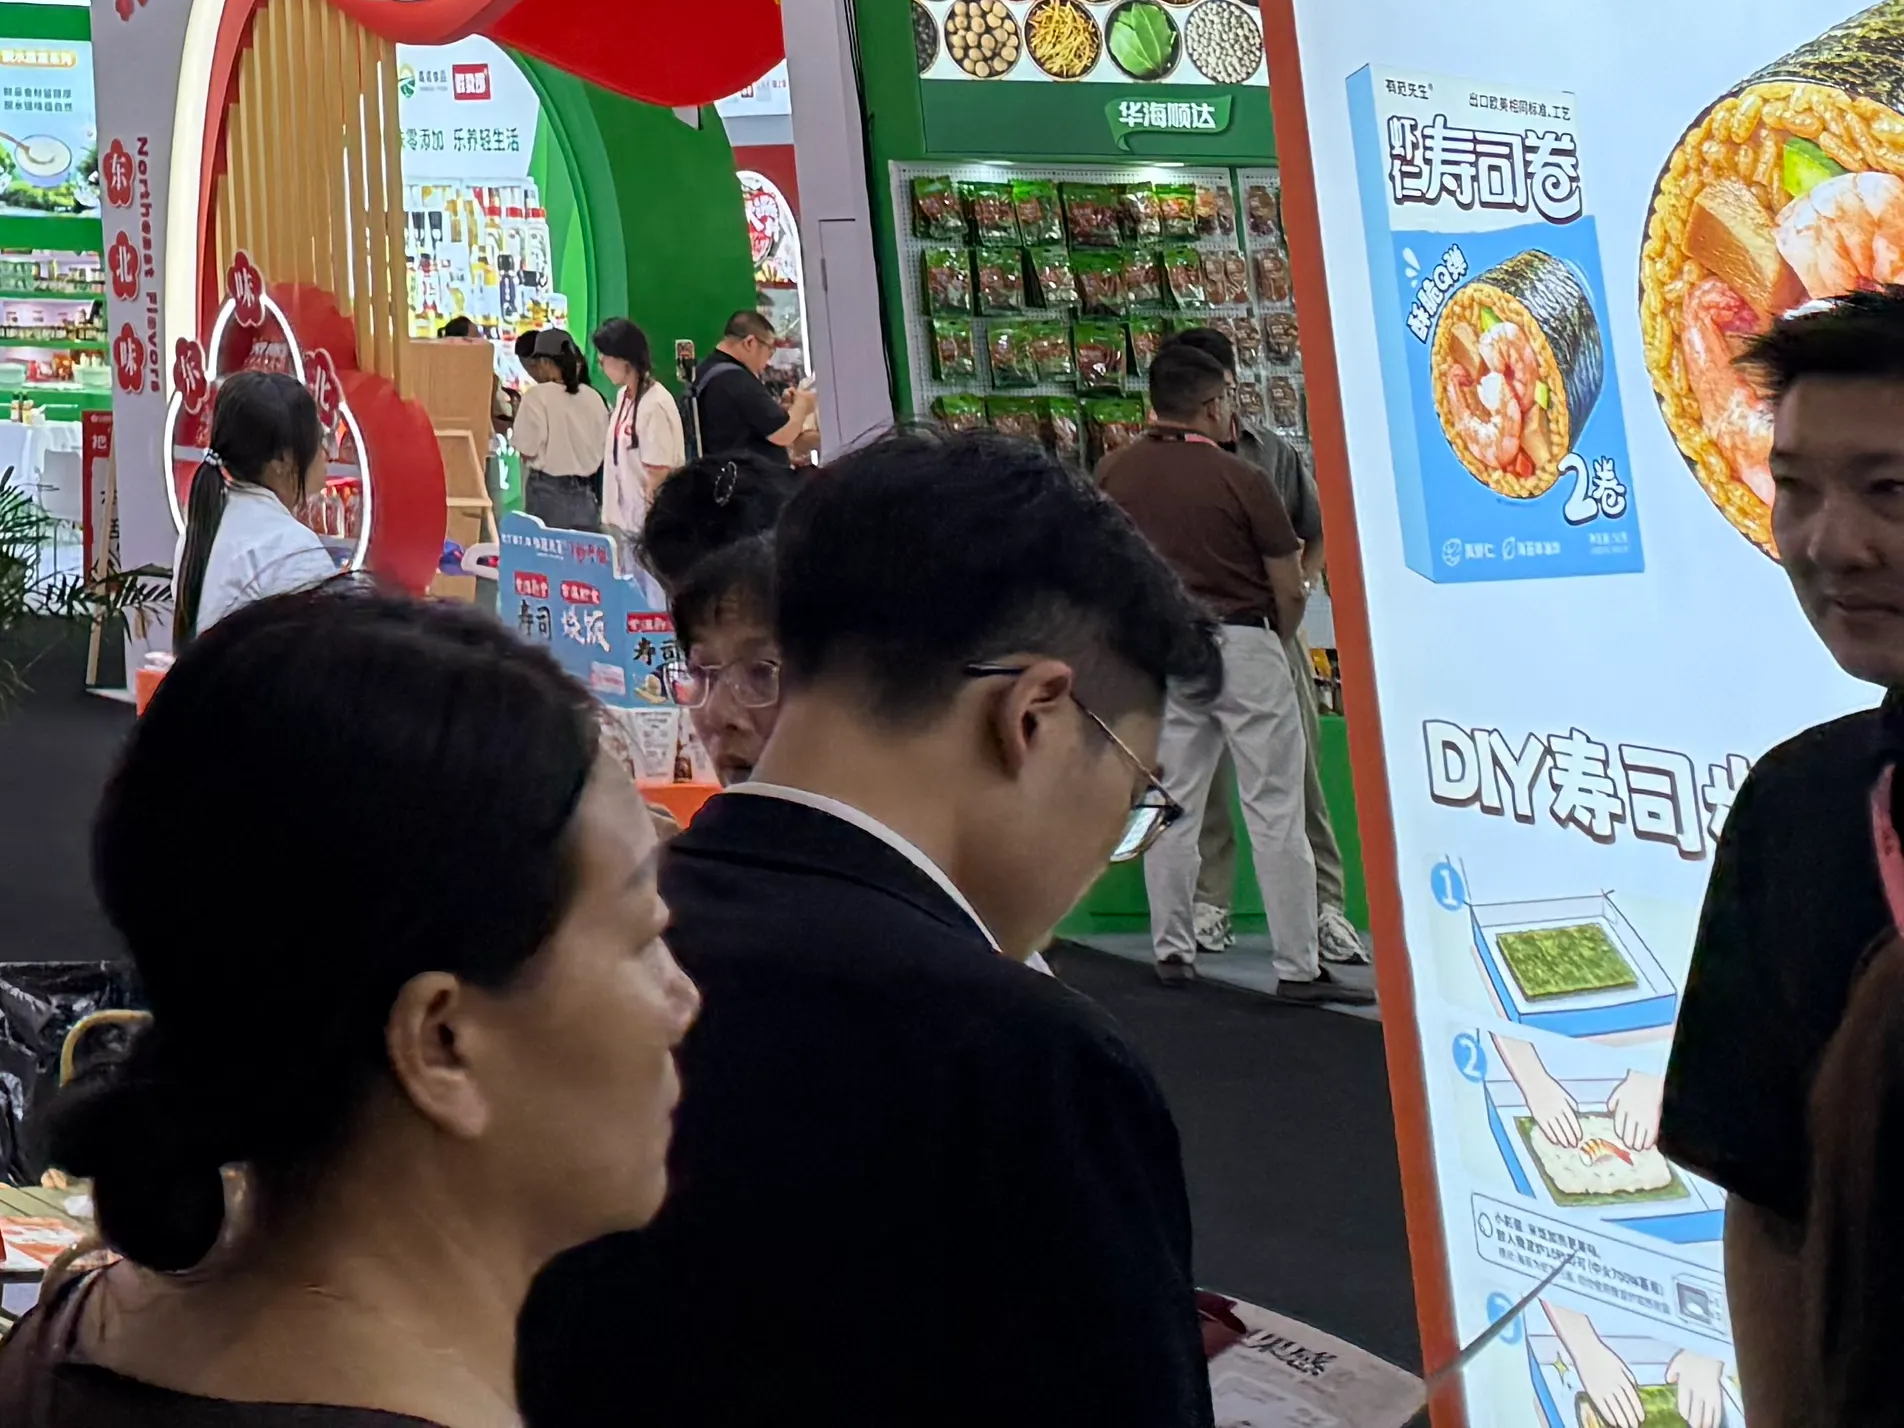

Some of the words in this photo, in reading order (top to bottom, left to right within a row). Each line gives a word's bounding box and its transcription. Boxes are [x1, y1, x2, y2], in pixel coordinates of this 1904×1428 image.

[1118, 101, 1216, 131] 华海顺达
[1421, 113, 1583, 226] 寿司卷
[137, 137, 156, 279] Northeast
[145, 292, 161, 393] Flavors
